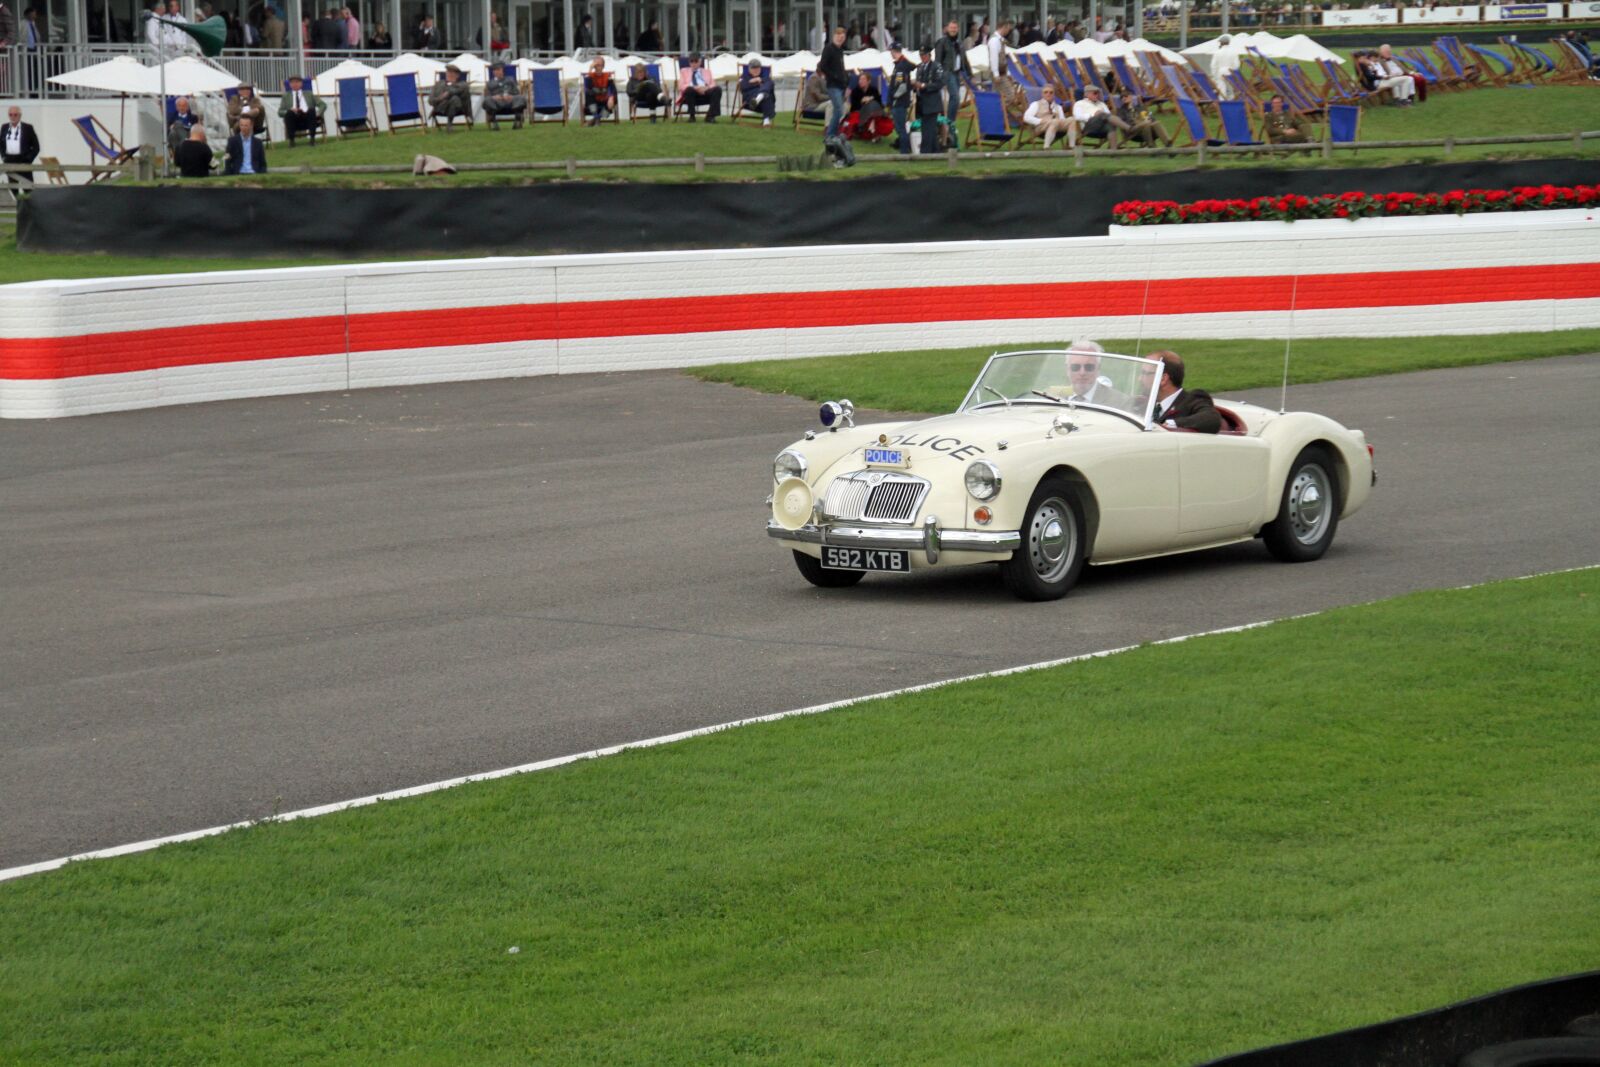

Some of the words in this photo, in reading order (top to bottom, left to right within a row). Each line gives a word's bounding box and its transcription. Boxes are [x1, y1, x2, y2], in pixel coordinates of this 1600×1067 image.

[865, 450, 902, 464] POLICE
[828, 548, 862, 568] 592
[866, 550, 902, 570] KTB
